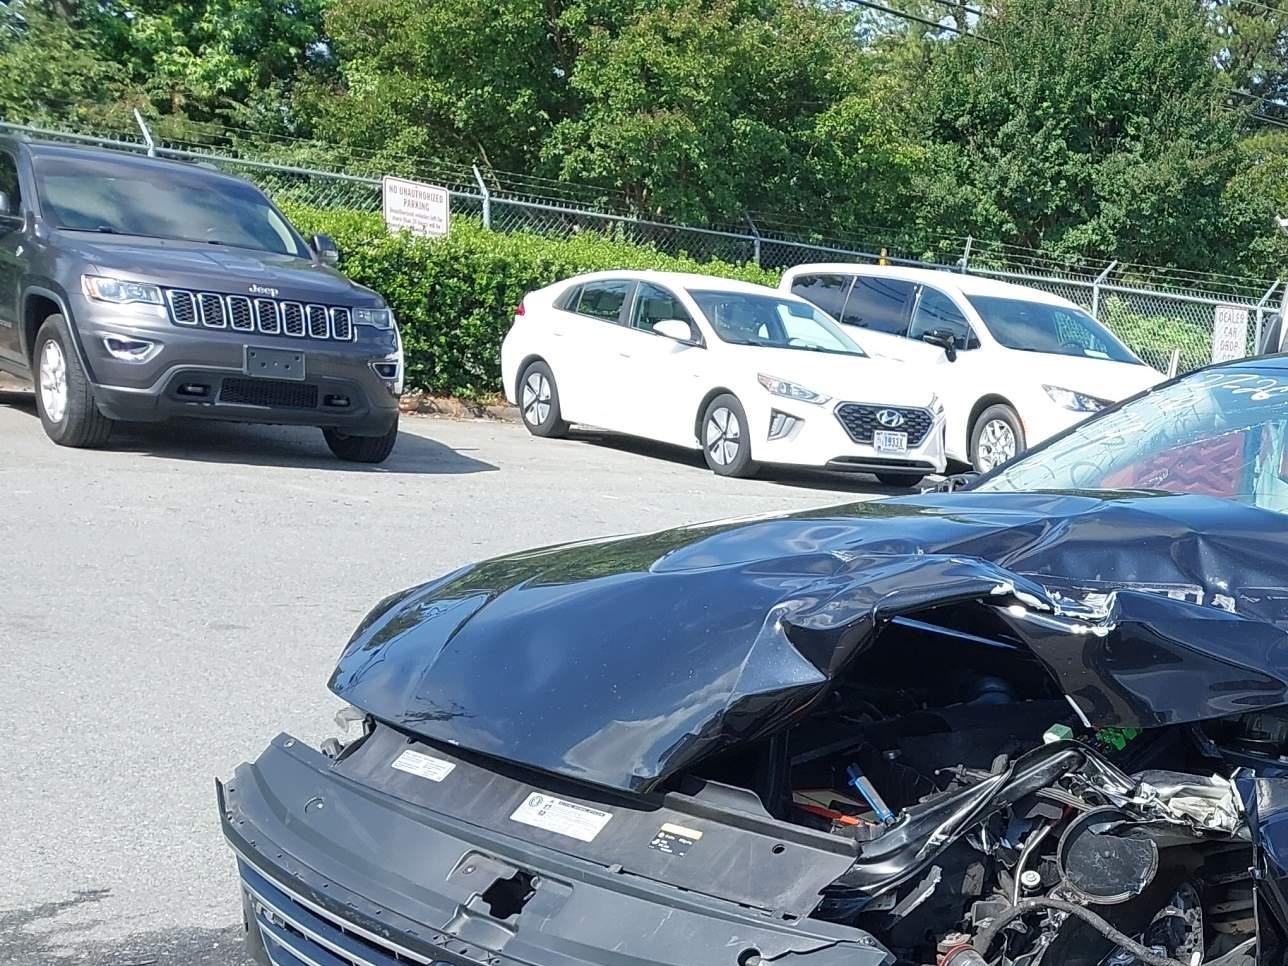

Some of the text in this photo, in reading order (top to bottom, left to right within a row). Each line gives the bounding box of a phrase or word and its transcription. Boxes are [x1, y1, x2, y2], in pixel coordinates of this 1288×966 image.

[388, 185, 443, 203] NO UNAUTHORIZED
[403, 198, 430, 211] PARKING
[249, 284, 279, 297] Jeep
[1219, 311, 1244, 324] DEALER
[1223, 326, 1237, 338] CAR
[1220, 339, 1239, 352] DROP
